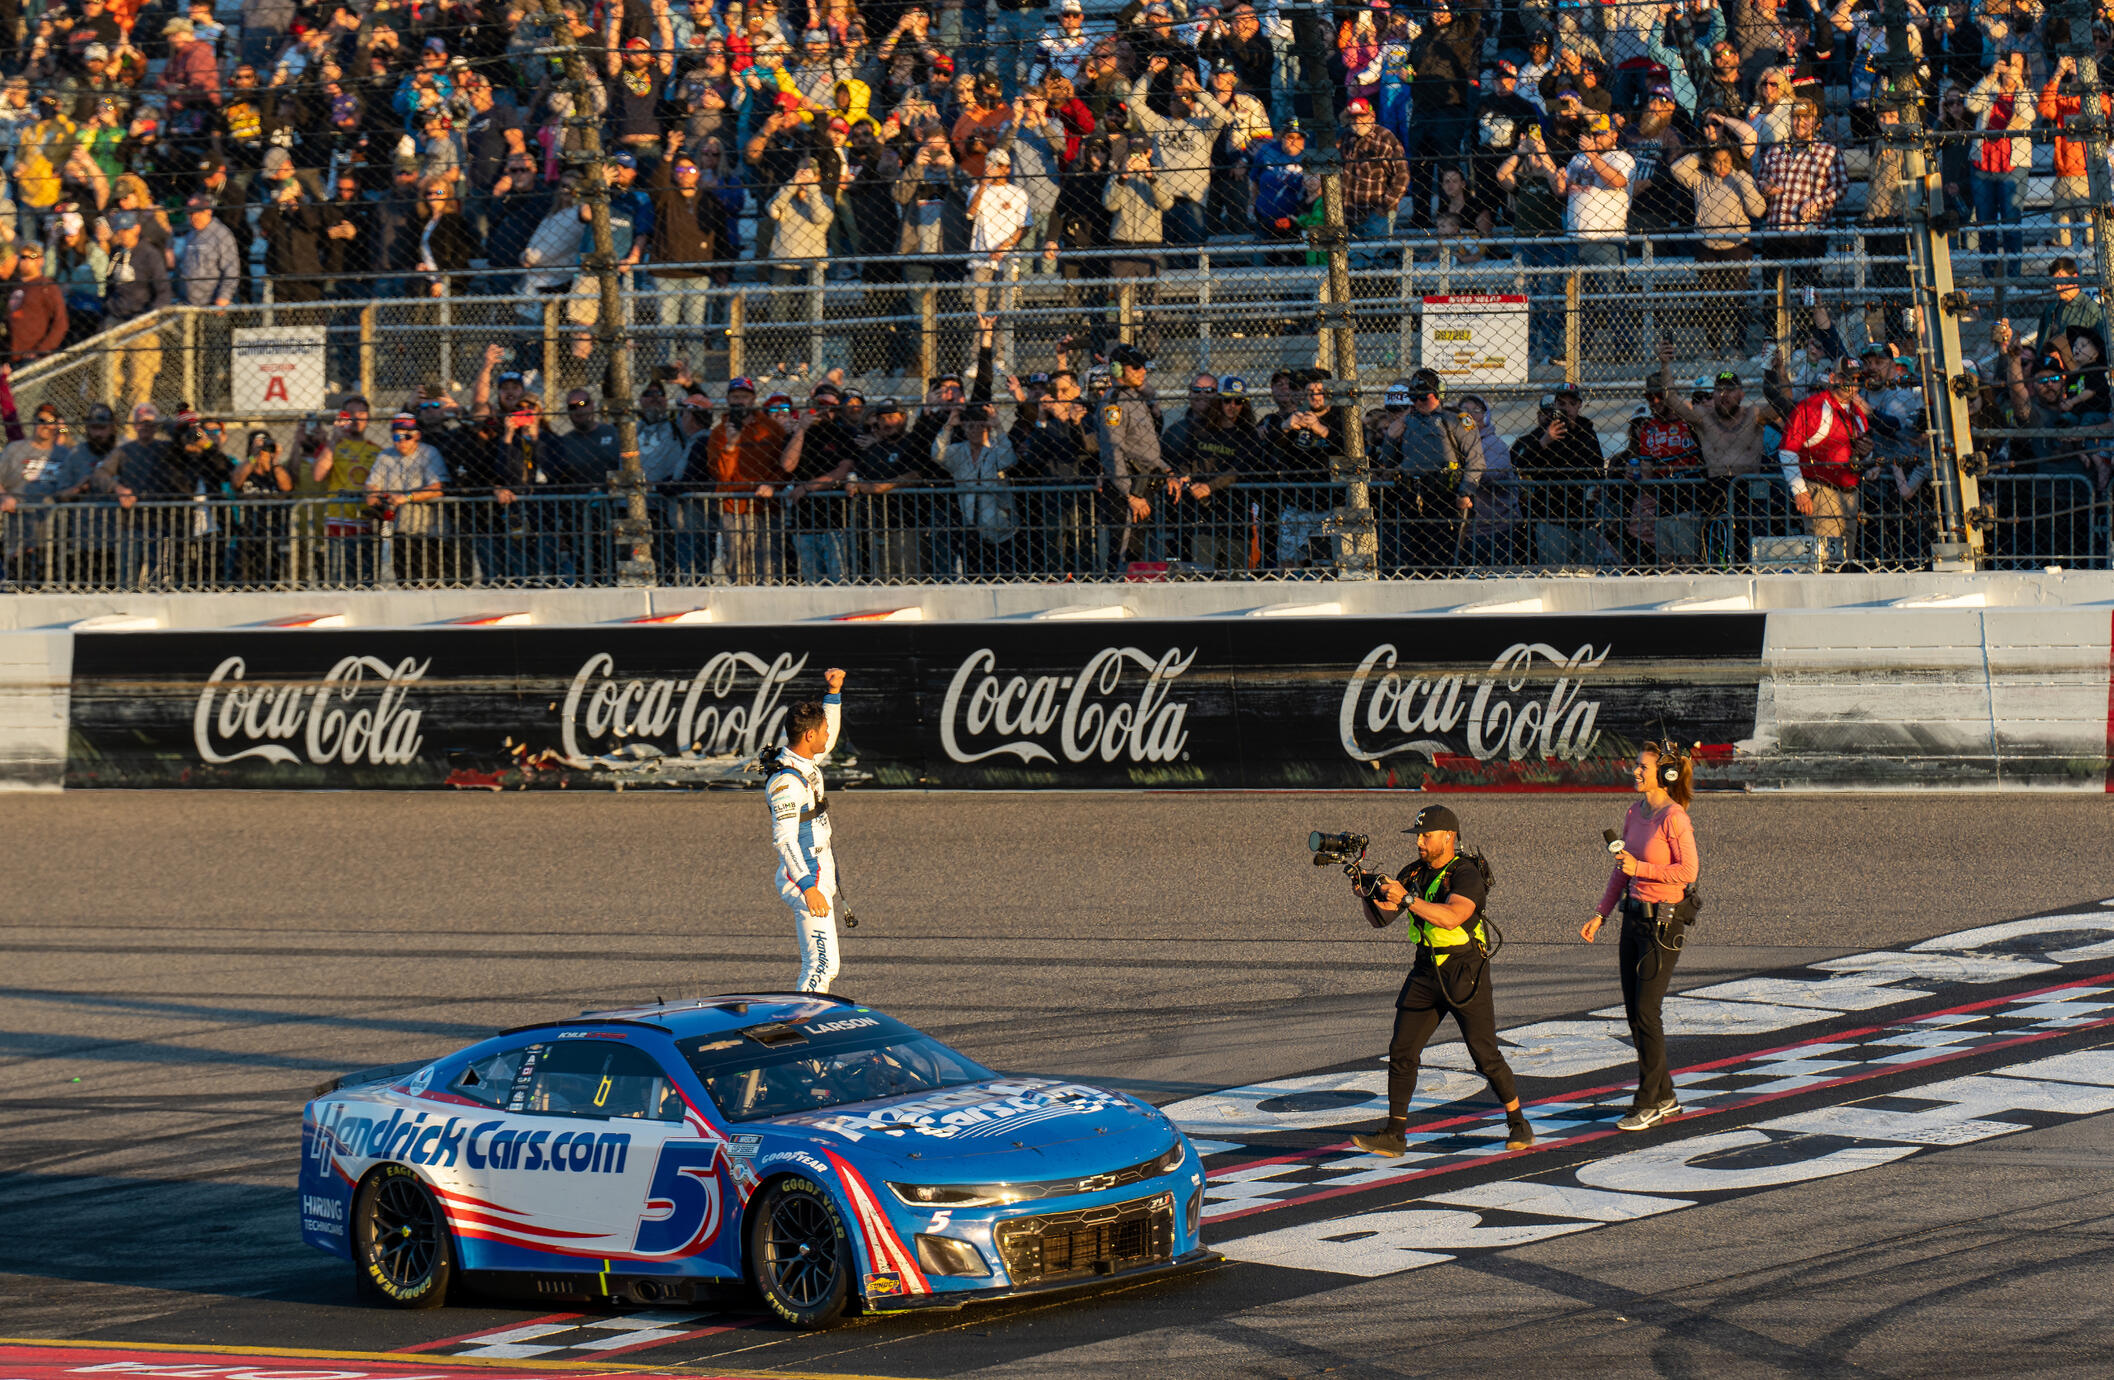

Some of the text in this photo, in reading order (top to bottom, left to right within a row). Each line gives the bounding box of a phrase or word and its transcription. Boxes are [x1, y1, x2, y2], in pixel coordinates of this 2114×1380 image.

[264, 376, 289, 401] A
[194, 655, 432, 766] Coca-Cola
[940, 646, 1198, 764] Coca-Cola
[1339, 643, 1612, 762] Coca-Cola
[804, 1017, 881, 1035] LARSON
[310, 1102, 632, 1178] HendrickCars.com
[303, 1194, 344, 1221] HIRING
[631, 1137, 722, 1256] 5
[926, 1209, 953, 1235] 5
